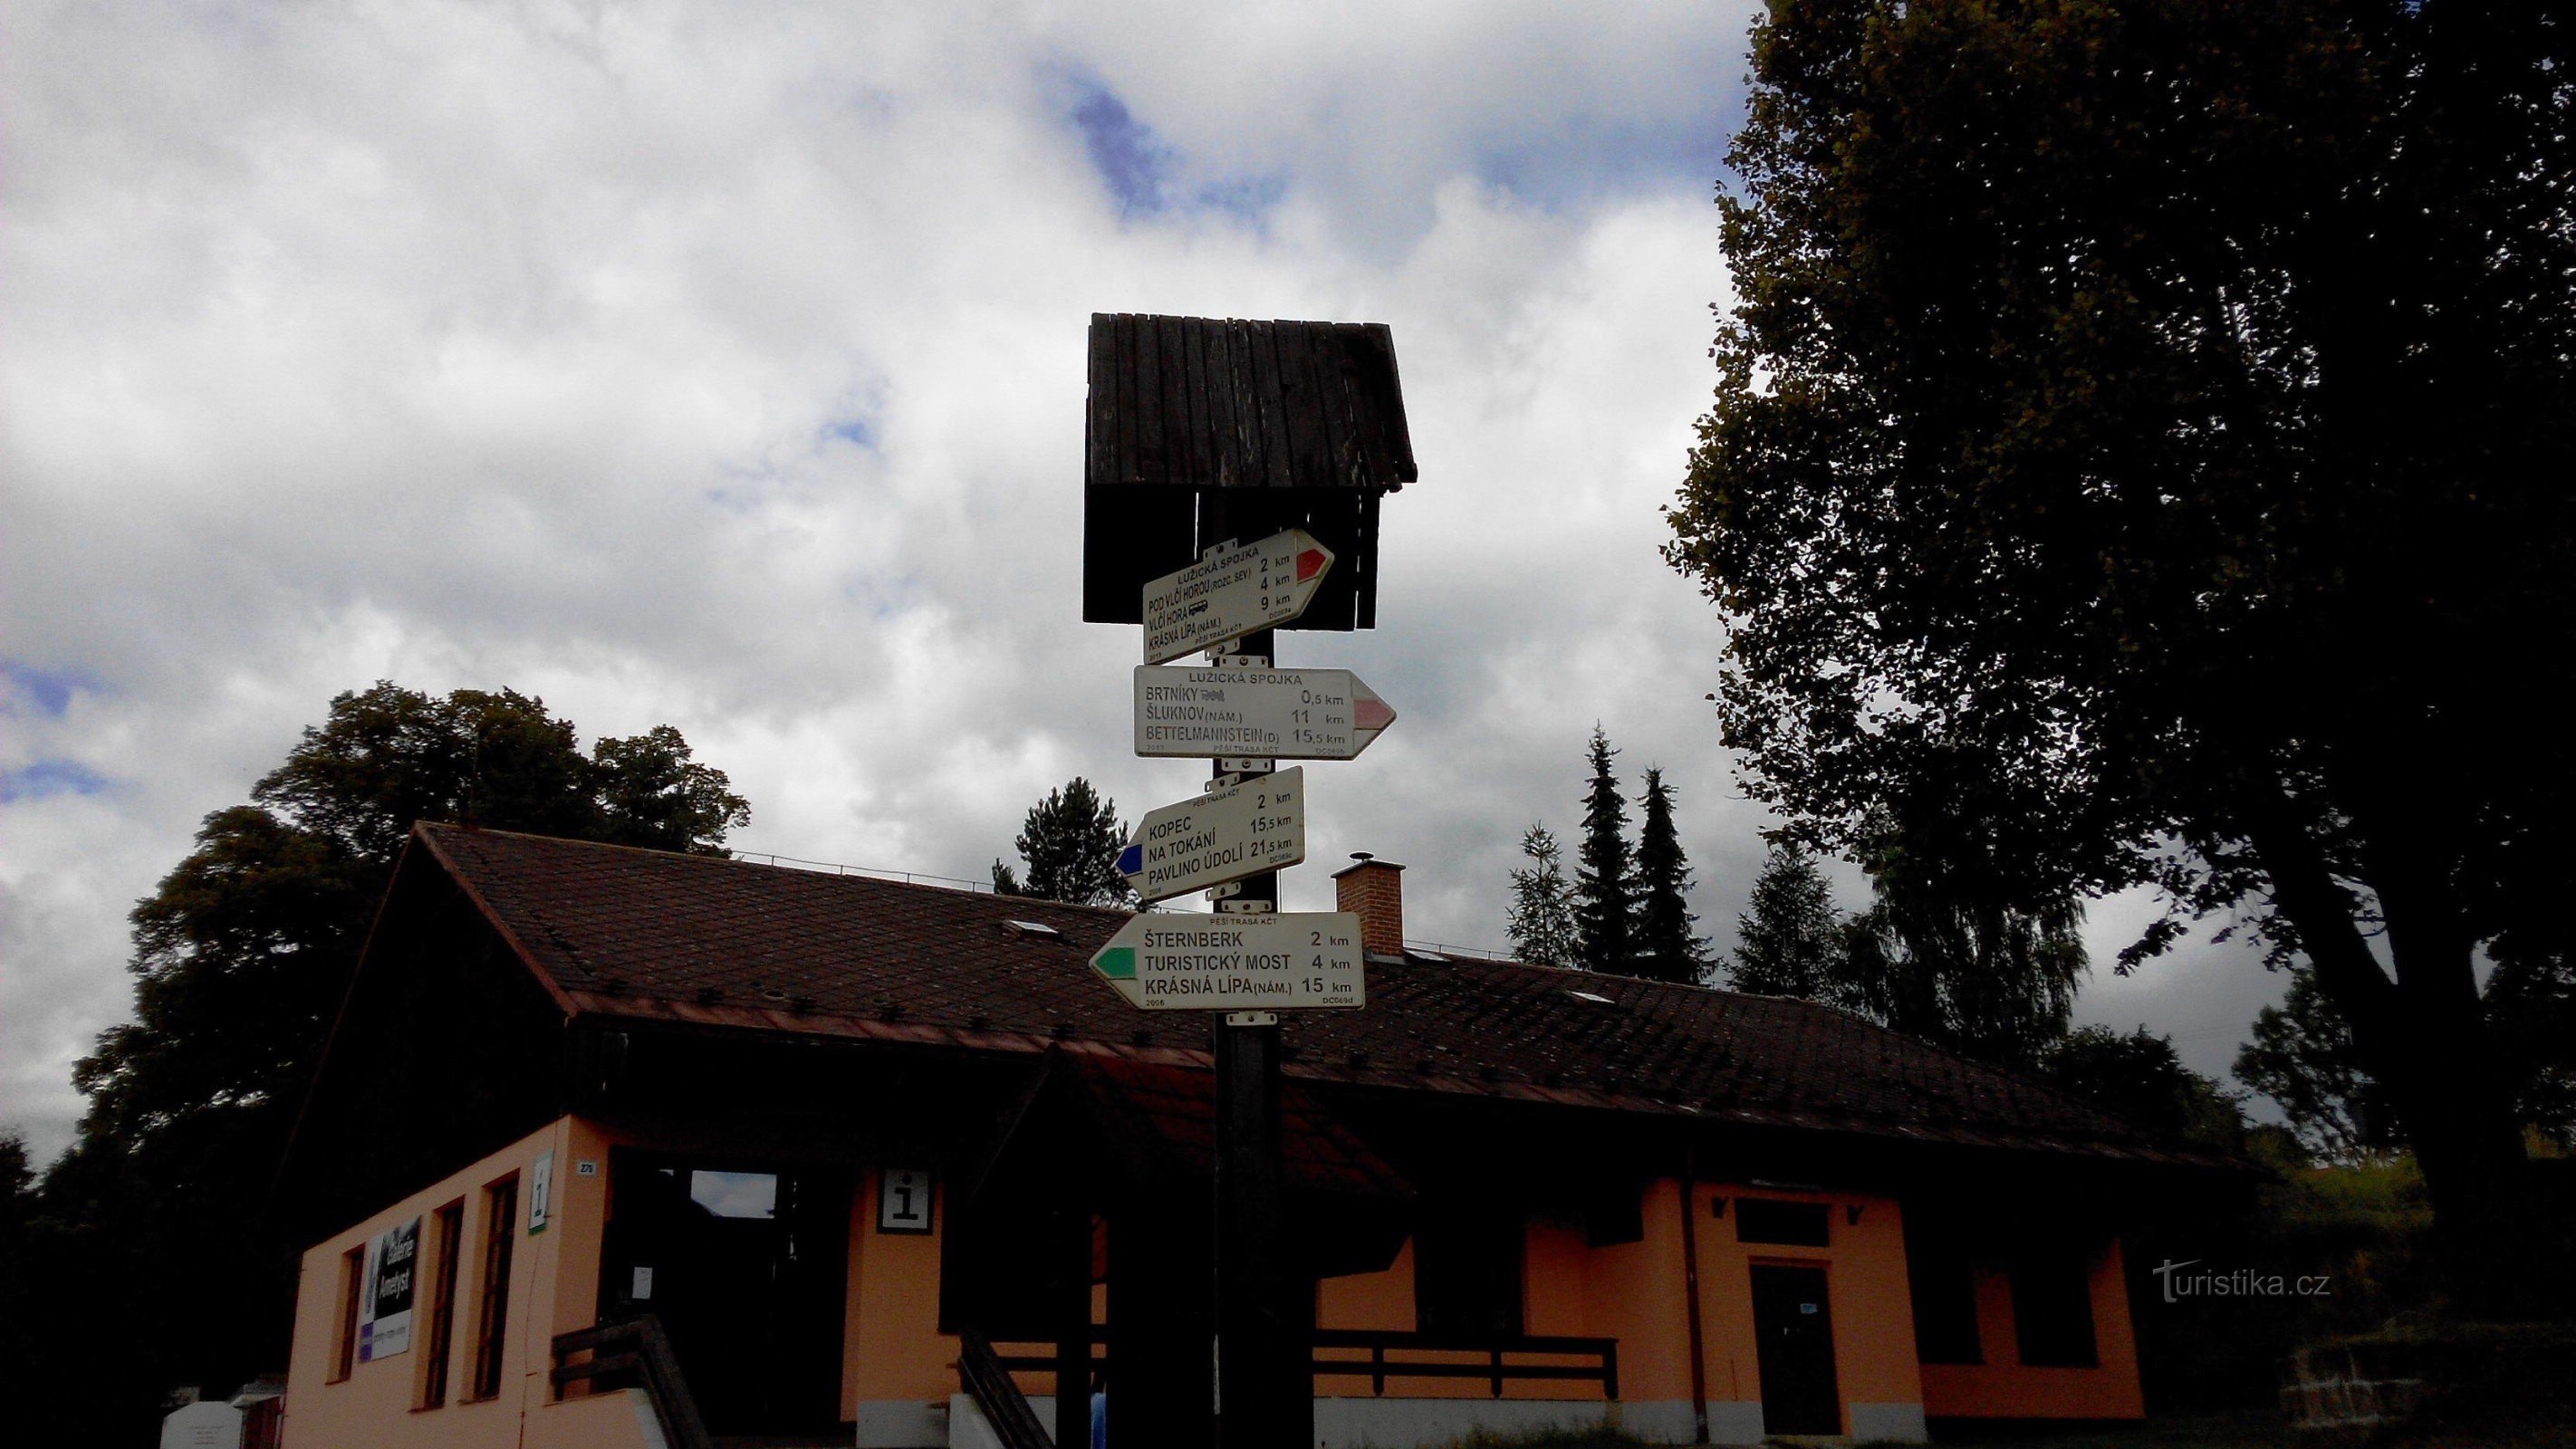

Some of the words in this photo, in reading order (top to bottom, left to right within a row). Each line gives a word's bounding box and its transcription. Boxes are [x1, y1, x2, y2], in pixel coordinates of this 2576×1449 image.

[1178, 559, 1218, 585] LUŽICKÁ
[1220, 547, 1259, 571] SPOJKA
[1261, 558, 1267, 573] 2
[1275, 555, 1290, 567] km
[1261, 577, 1267, 590] 4
[1276, 575, 1290, 587] km
[1149, 597, 1164, 614] POD
[1165, 588, 1182, 607] VLČÍ
[1261, 597, 1268, 610] 9
[1276, 595, 1290, 606] km
[1149, 614, 1166, 632] VLČÍ
[1167, 606, 1187, 624] HORA
[1149, 625, 1178, 651] KRÁSNÁ
[1188, 671, 1245, 684] LUŽICKÁ
[1250, 674, 1302, 685] SPOJKA
[1147, 685, 1197, 701] BRTNÍKY
[1301, 690, 1322, 705] 0,5
[1325, 696, 1343, 705] km
[1292, 710, 1310, 724] 11
[1326, 715, 1344, 724] km
[1293, 730, 1323, 744] 15,5
[1327, 734, 1344, 744] km
[1258, 794, 1265, 810] 2
[1276, 792, 1291, 804] km
[1149, 816, 1191, 841] KOPEC
[1251, 818, 1274, 834] 15,5
[1277, 815, 1292, 827] km
[1149, 846, 1166, 864] NA
[1168, 828, 1216, 857] TOKÁNÍ
[1251, 840, 1275, 857] 21,5
[1278, 839, 1292, 850] km
[1149, 858, 1200, 886] PAVLINO
[1205, 842, 1243, 869] ÚDOLÍ
[1145, 929, 1243, 948] ŠTERNBERK
[1311, 932, 1321, 946] 2
[1330, 936, 1349, 945] km
[1145, 951, 1239, 971] TURISTICKÝ
[1245, 955, 1291, 970] MOST
[1312, 955, 1322, 969] 4
[1331, 959, 1350, 969] km
[1145, 975, 1212, 995] KRÁSNÁ
[1302, 979, 1323, 993] 15
[1332, 983, 1351, 993] km
